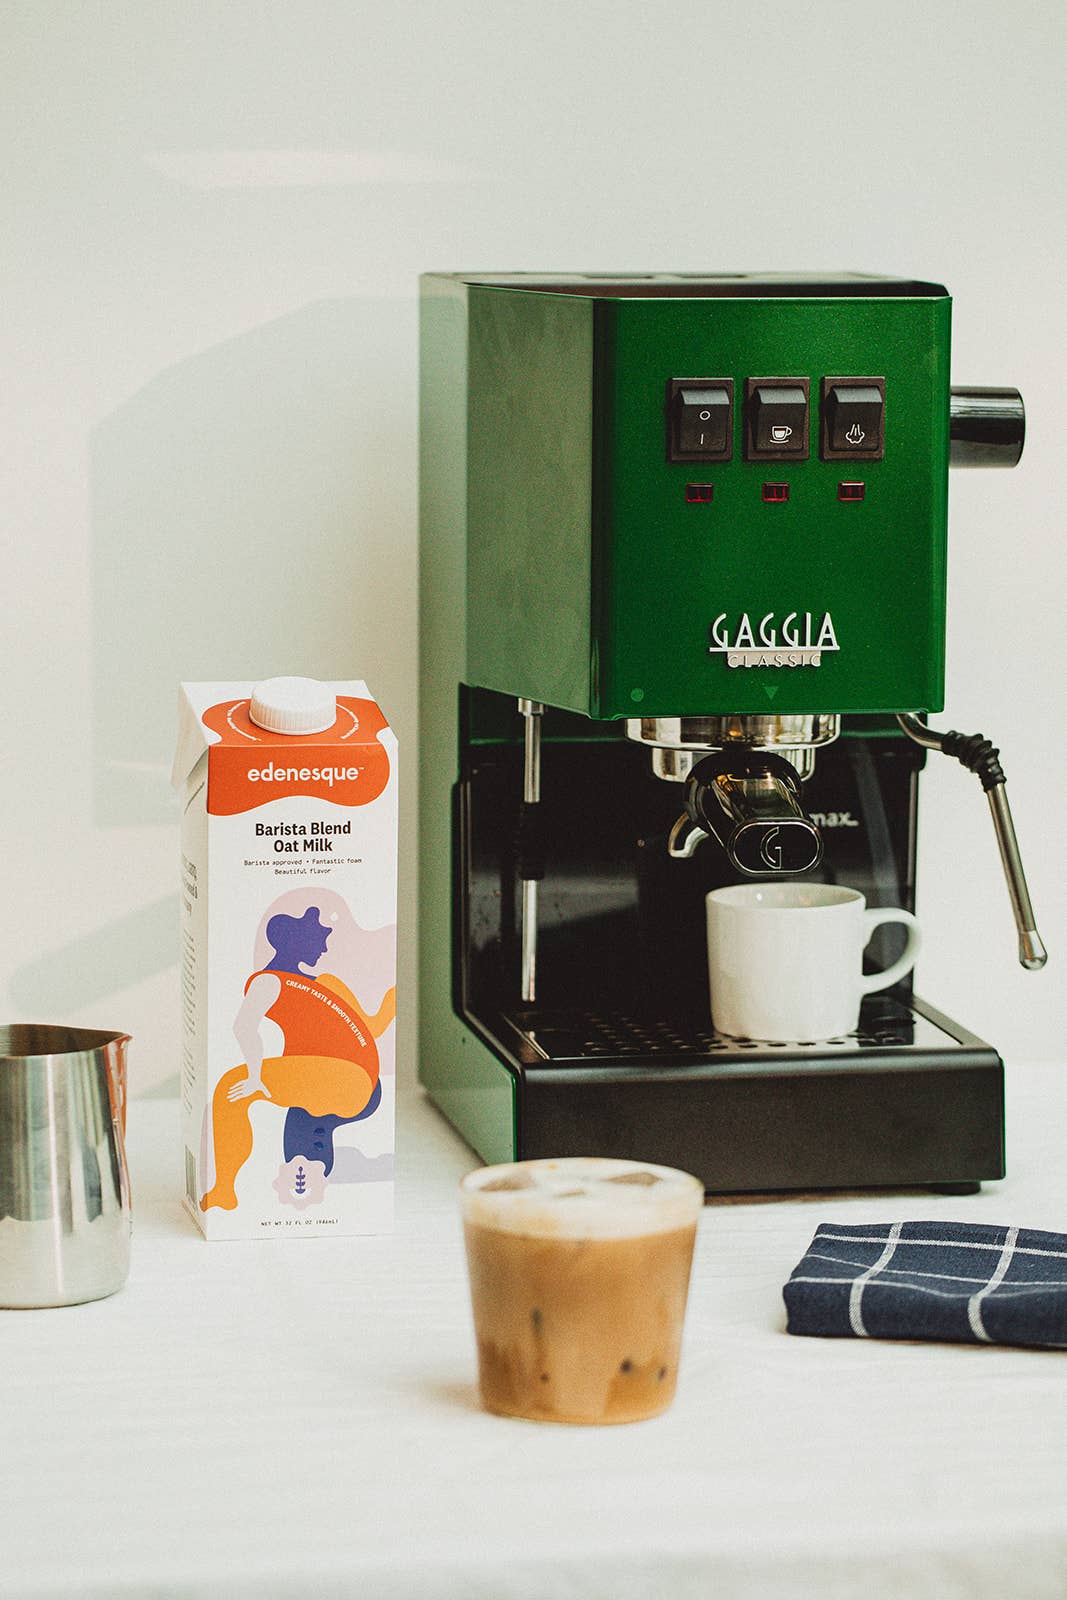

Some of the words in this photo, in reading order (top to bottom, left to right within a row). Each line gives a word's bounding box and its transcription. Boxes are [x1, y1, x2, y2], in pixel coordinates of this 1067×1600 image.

[711, 612, 839, 650] GAGGIA
[727, 653, 822, 668] CLASSIC
[247, 761, 359, 787] edenesque
[255, 822, 307, 836] Barista
[311, 820, 351, 835] Blend
[273, 839, 299, 853] Oat
[303, 838, 333, 852] Milk
[272, 859, 302, 867] approved
[285, 979, 310, 992] CREAMY
[311, 988, 328, 1002] TASTE
[331, 1003, 352, 1024] SMOOTH
[350, 1022, 367, 1047] TEXTURE
